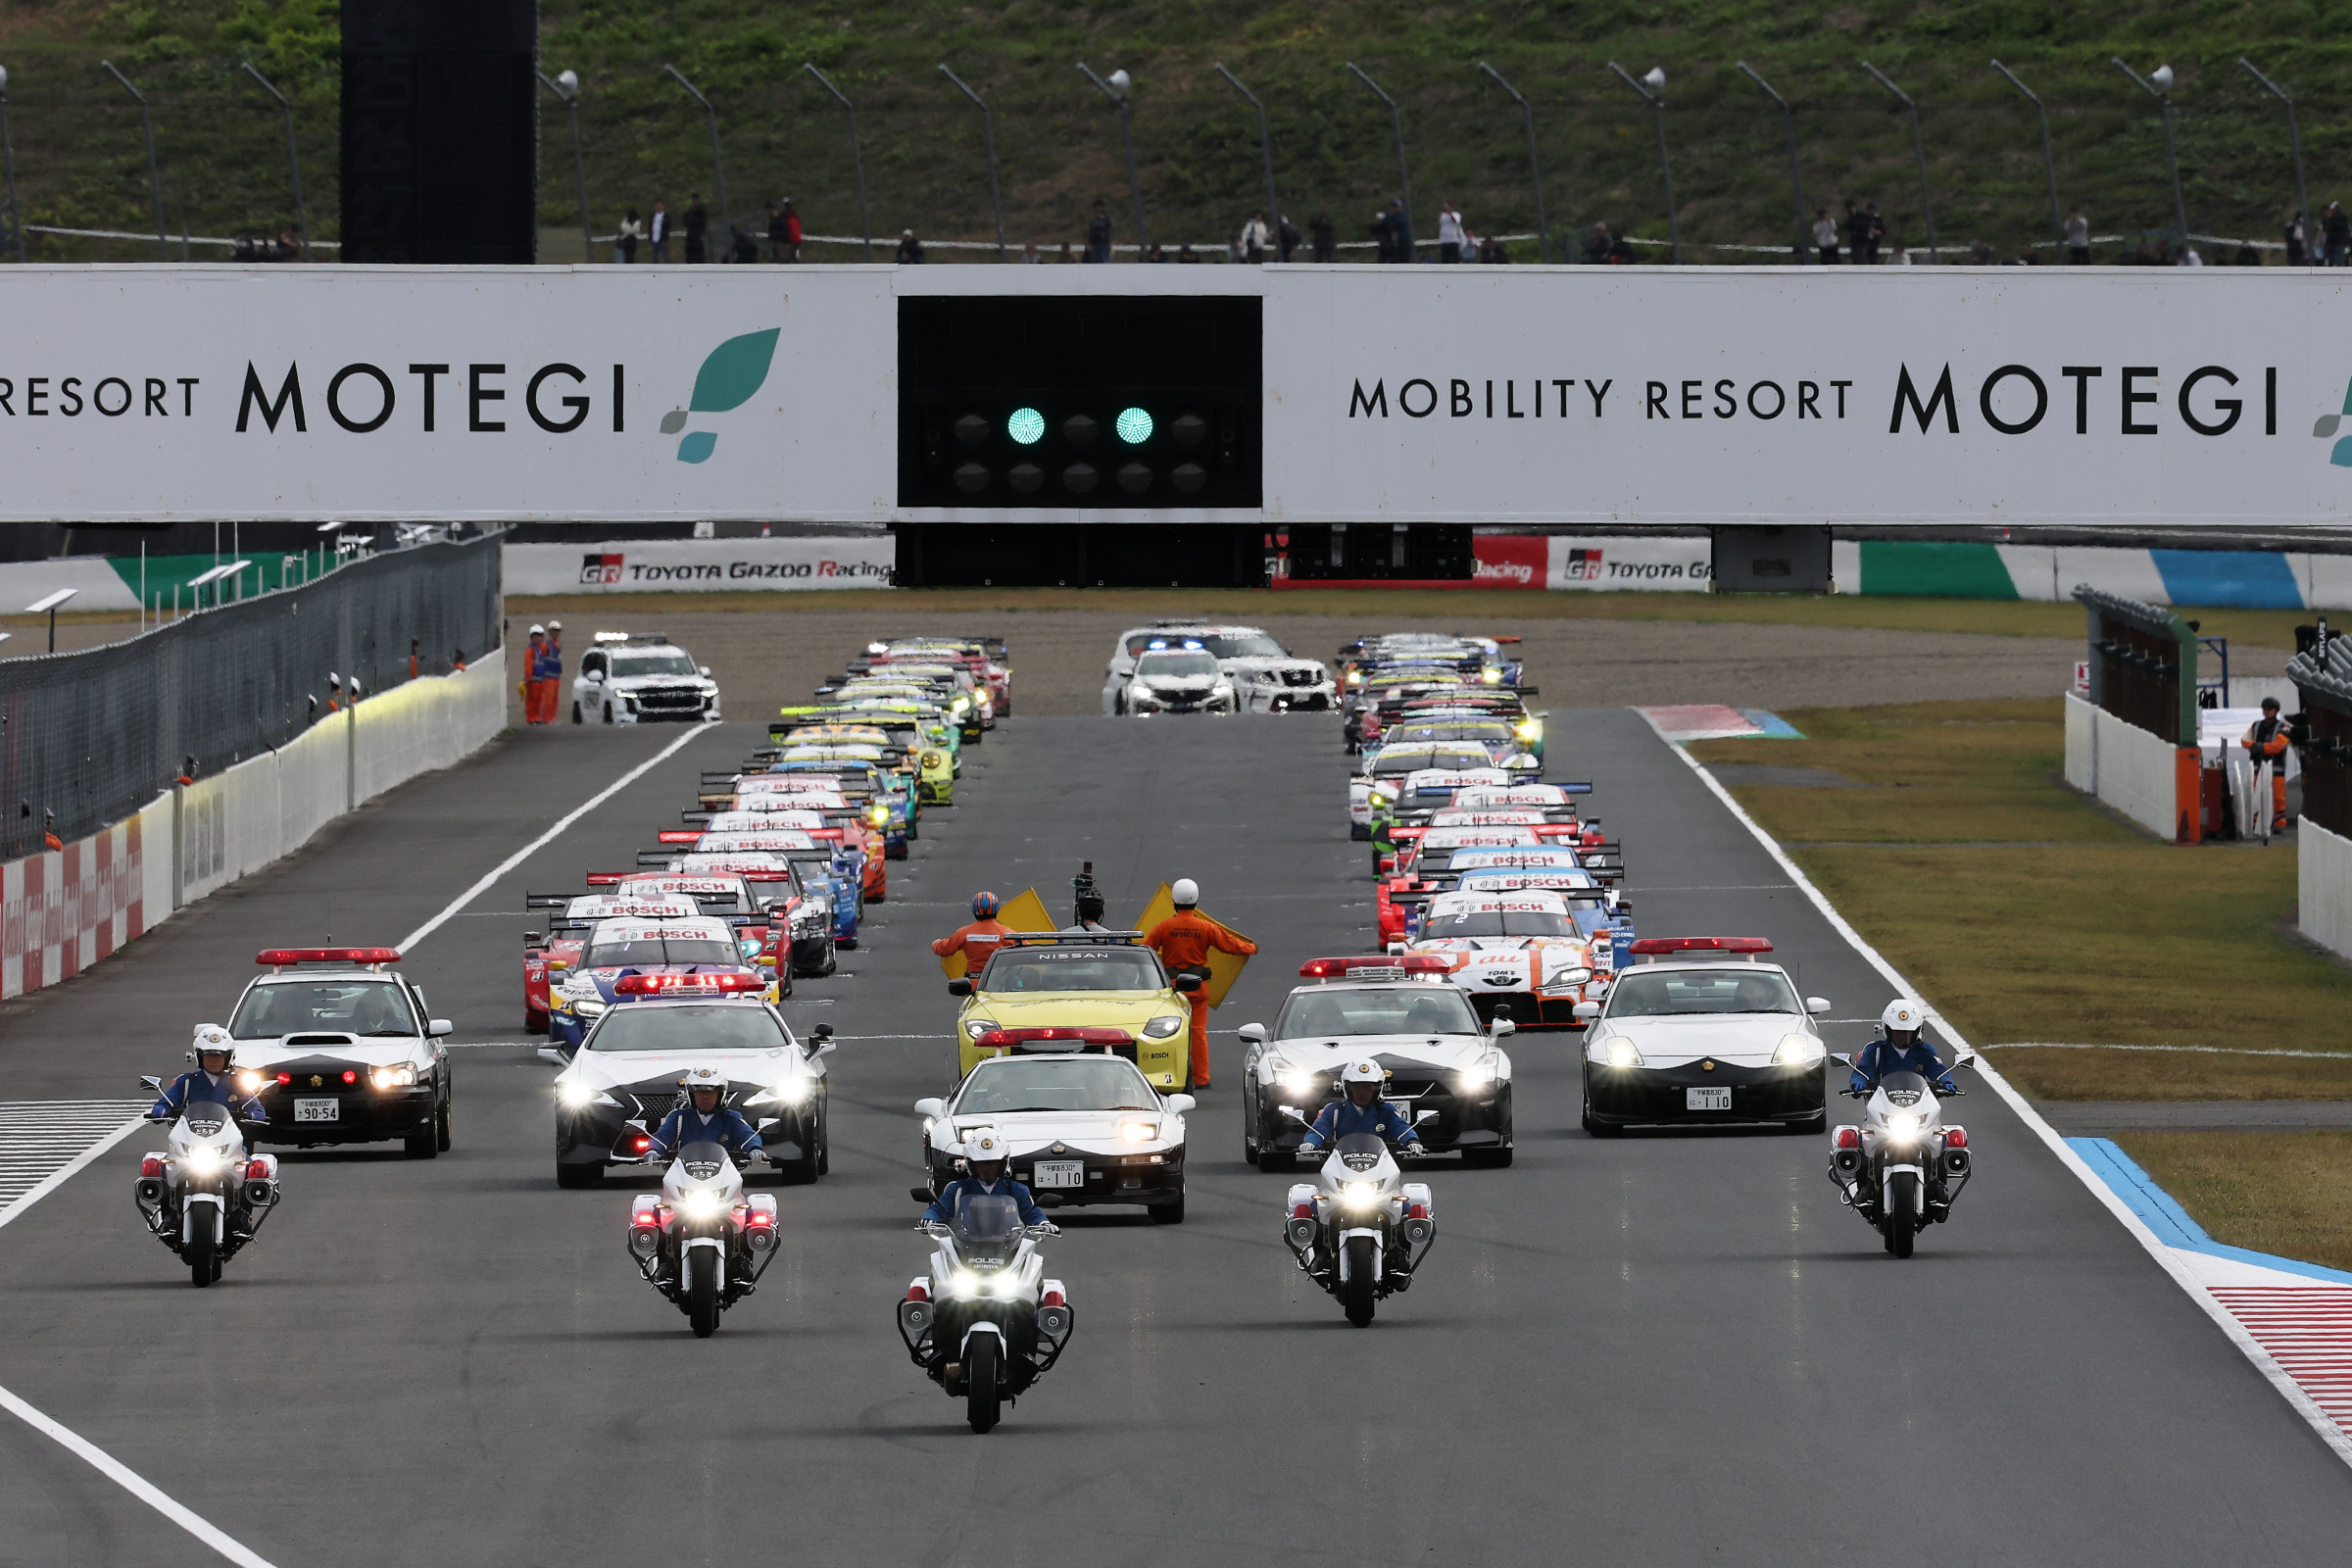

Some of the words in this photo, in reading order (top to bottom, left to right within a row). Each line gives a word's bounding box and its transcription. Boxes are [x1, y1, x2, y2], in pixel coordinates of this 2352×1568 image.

[235, 360, 623, 434] MOTEGI
[1348, 377, 1613, 418] MOBILITY
[1646, 378, 1853, 419] RESORT
[1889, 362, 2278, 436] MOTEGI
[630, 564, 722, 581] TOYOTA
[817, 560, 892, 582] Racing
[1473, 560, 1533, 584] acing
[1608, 562, 1683, 580] TOYOTA
[662, 882, 726, 891] BOSCH
[1454, 913, 1469, 925] 2
[644, 930, 708, 940] BOSCH
[1479, 956, 1524, 964] au
[304, 1107, 337, 1119] 90-54
